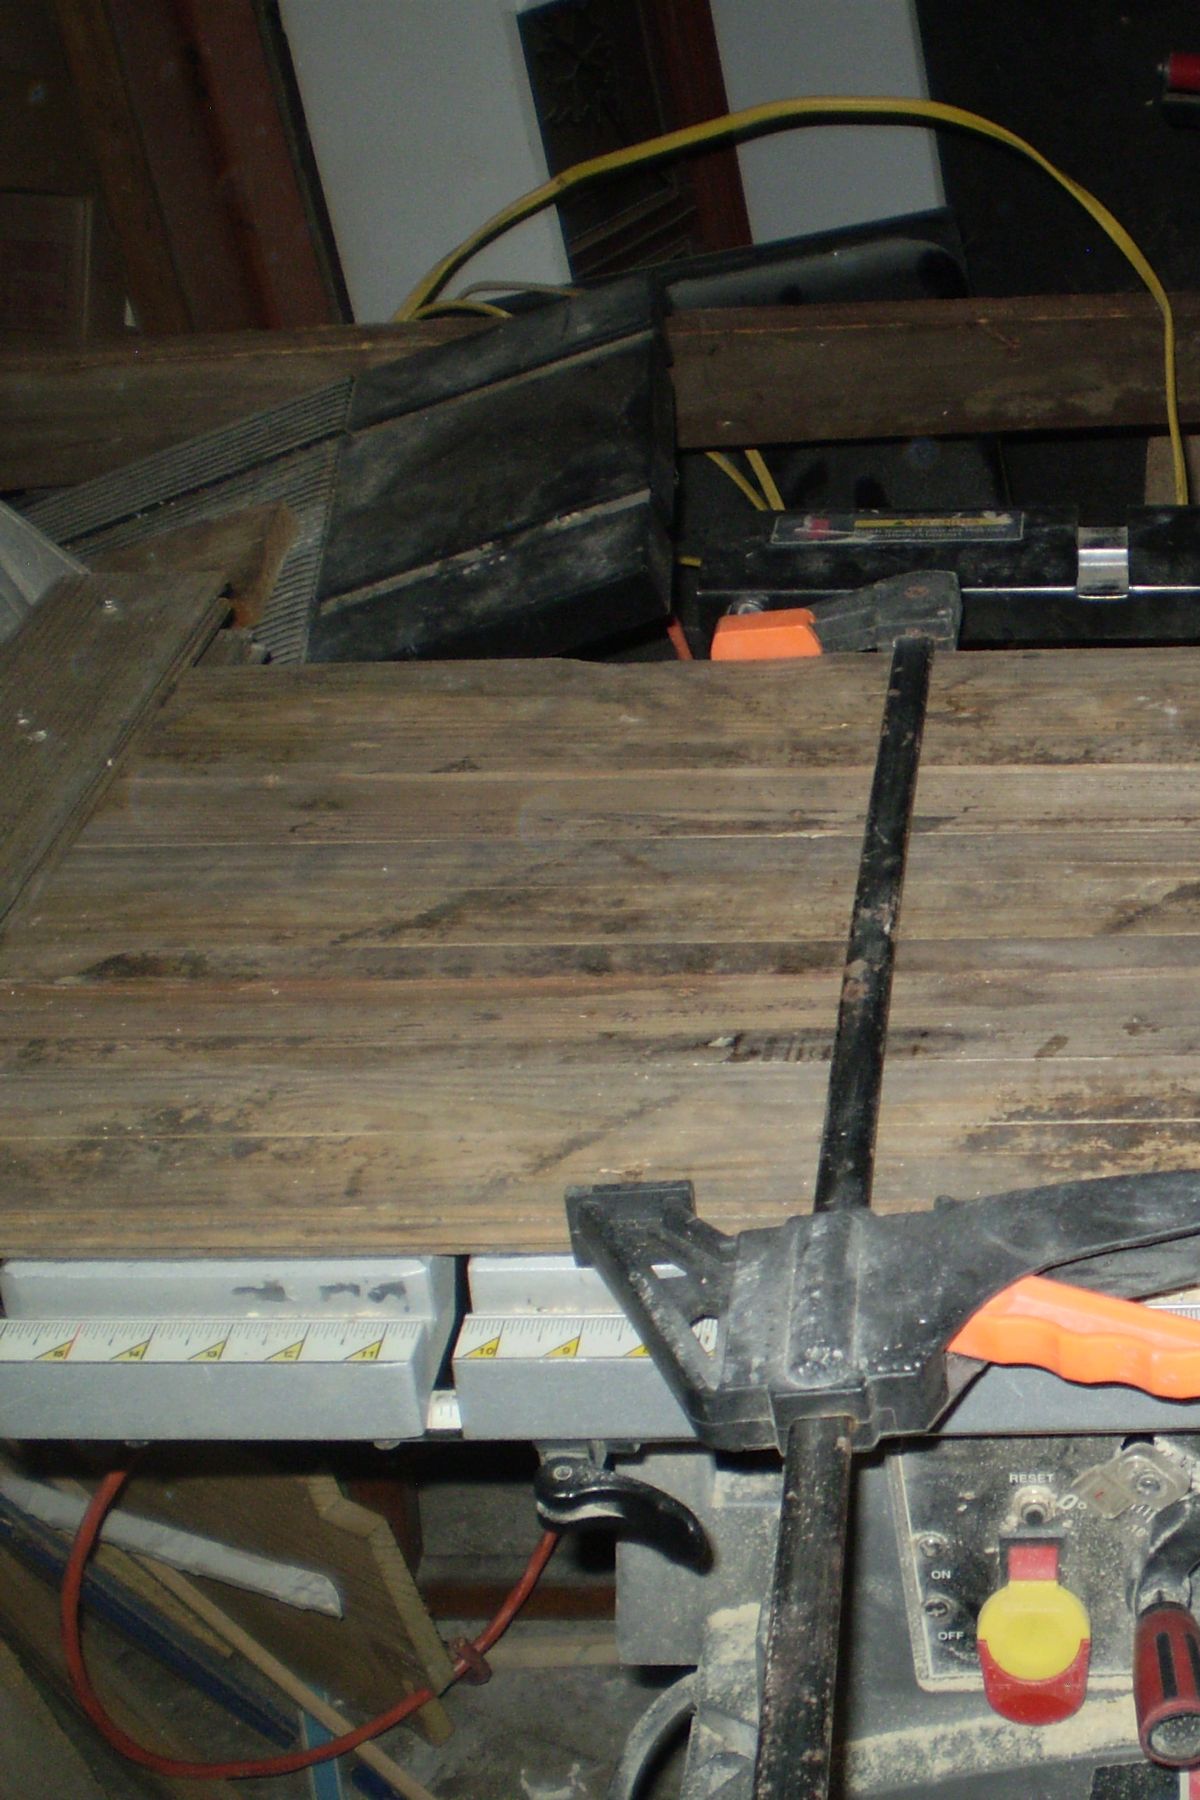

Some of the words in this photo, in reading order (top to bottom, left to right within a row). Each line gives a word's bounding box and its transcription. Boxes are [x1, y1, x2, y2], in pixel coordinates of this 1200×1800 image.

[480, 1346, 494, 1355] 10
[1009, 1472, 1055, 1484] RESET
[931, 1570, 951, 1580] ON
[937, 1631, 965, 1641] OFF
